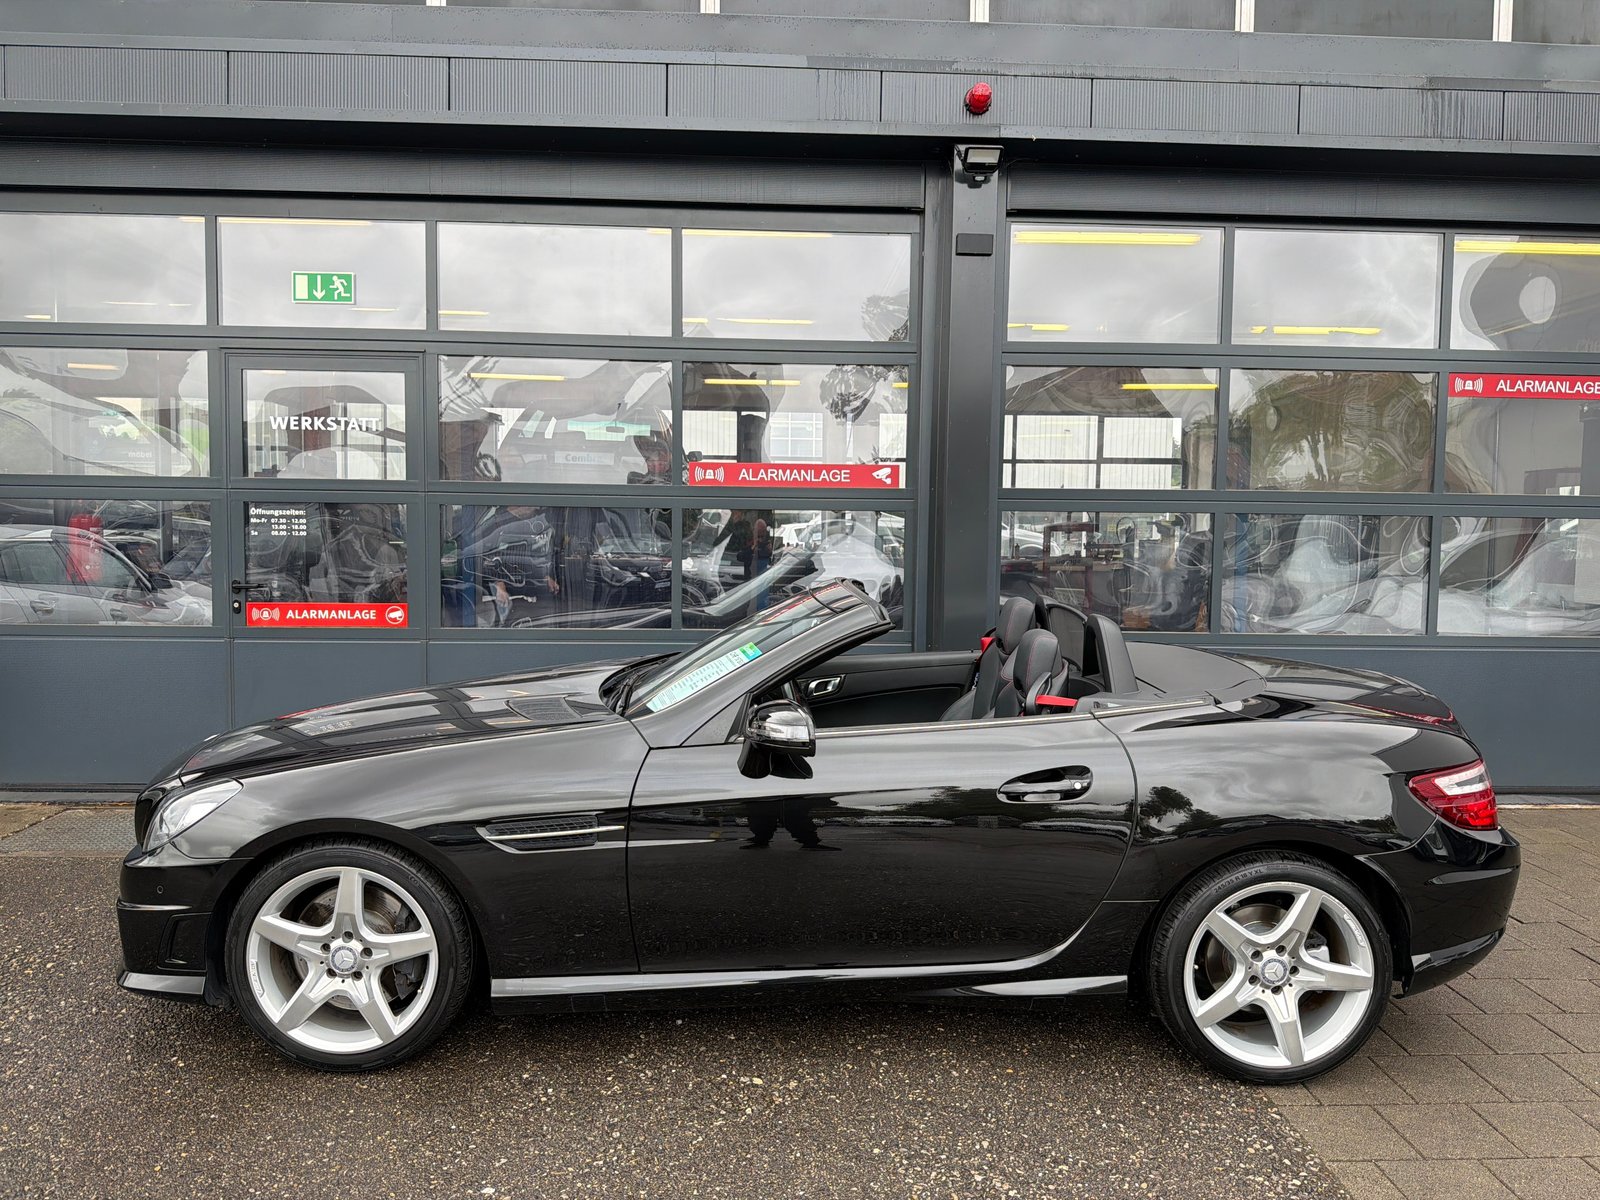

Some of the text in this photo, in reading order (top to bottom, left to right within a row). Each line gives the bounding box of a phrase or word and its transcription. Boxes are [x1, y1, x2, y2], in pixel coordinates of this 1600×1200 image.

[269, 415, 380, 432] WERKSTATT
[738, 467, 850, 483] ALARMANLAGE
[250, 507, 306, 516] Öffnungszeiten:
[286, 609, 377, 620] ALARMANLAGE
